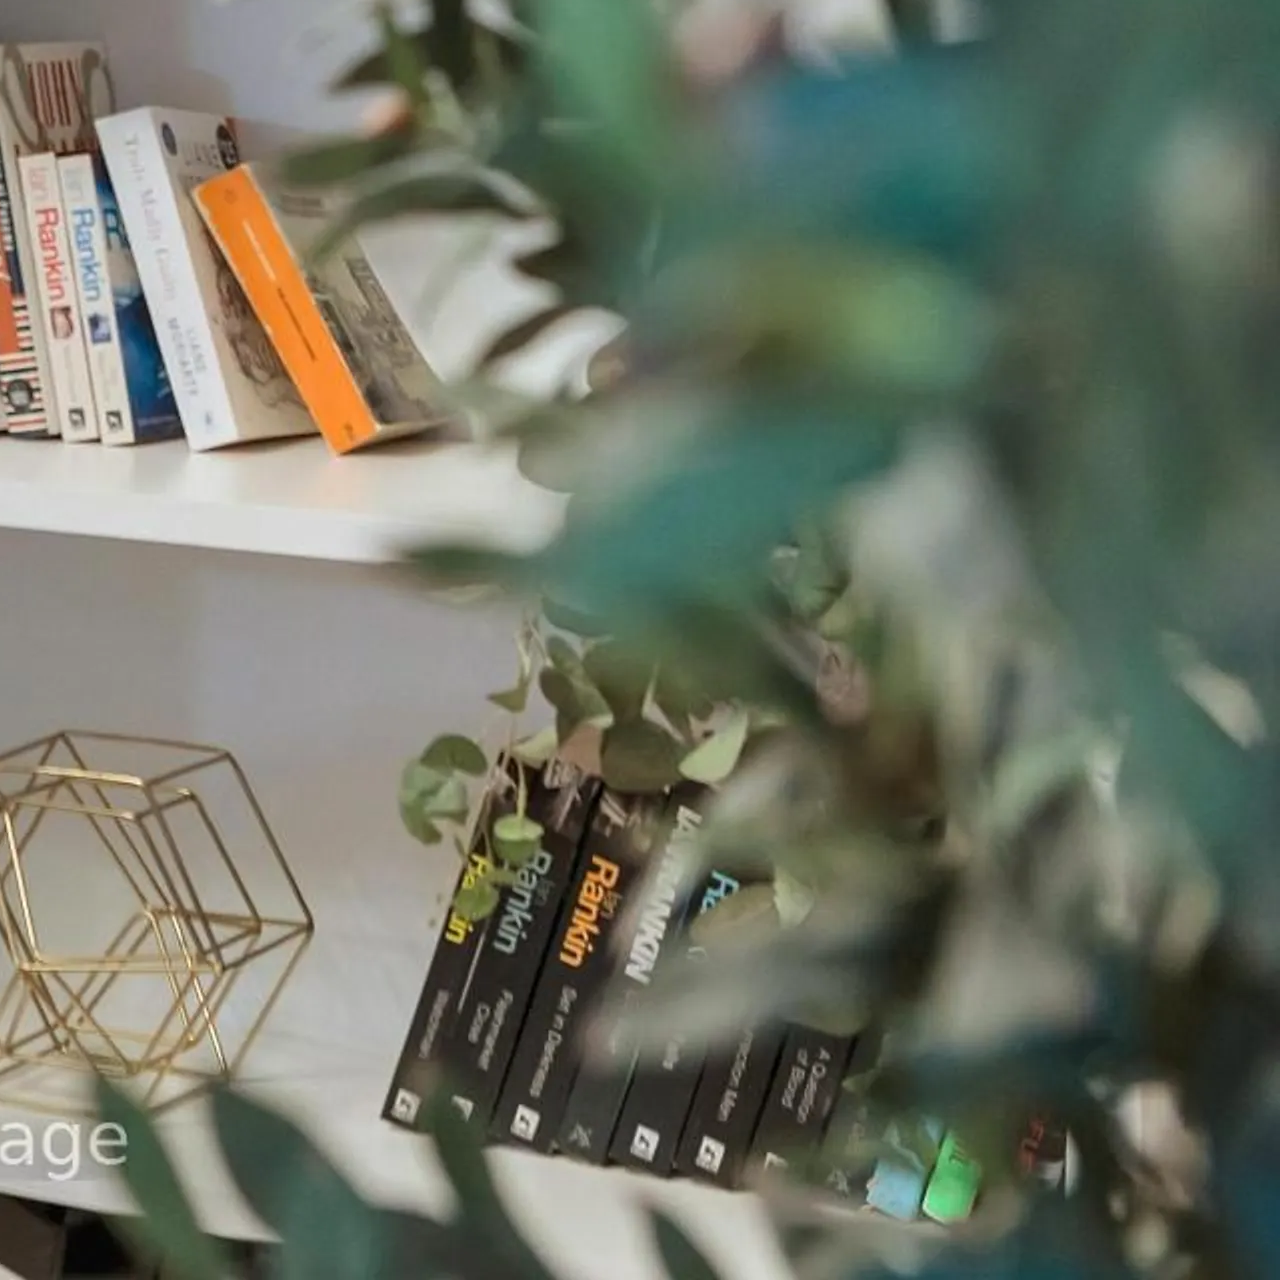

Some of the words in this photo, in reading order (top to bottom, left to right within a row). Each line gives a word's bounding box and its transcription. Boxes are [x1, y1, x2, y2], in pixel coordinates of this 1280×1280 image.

[28, 166, 50, 204] Ian
[34, 207, 66, 301] Rankin
[71, 207, 102, 302] Rankin
[444, 853, 490, 945] Rain
[493, 848, 553, 955] Rankin
[559, 854, 621, 968] Rankin
[604, 891, 623, 918] Ian
[624, 857, 678, 986] RANKIN
[468, 1001, 491, 1045] Close
[559, 984, 579, 1015] Set
[528, 1030, 563, 1099] Darkness
[796, 1048, 809, 1067] of
[818, 1047, 831, 1062] A
[717, 1090, 738, 1123] Men
[781, 1065, 807, 1110] Blood
[796, 1063, 827, 1125] Question
